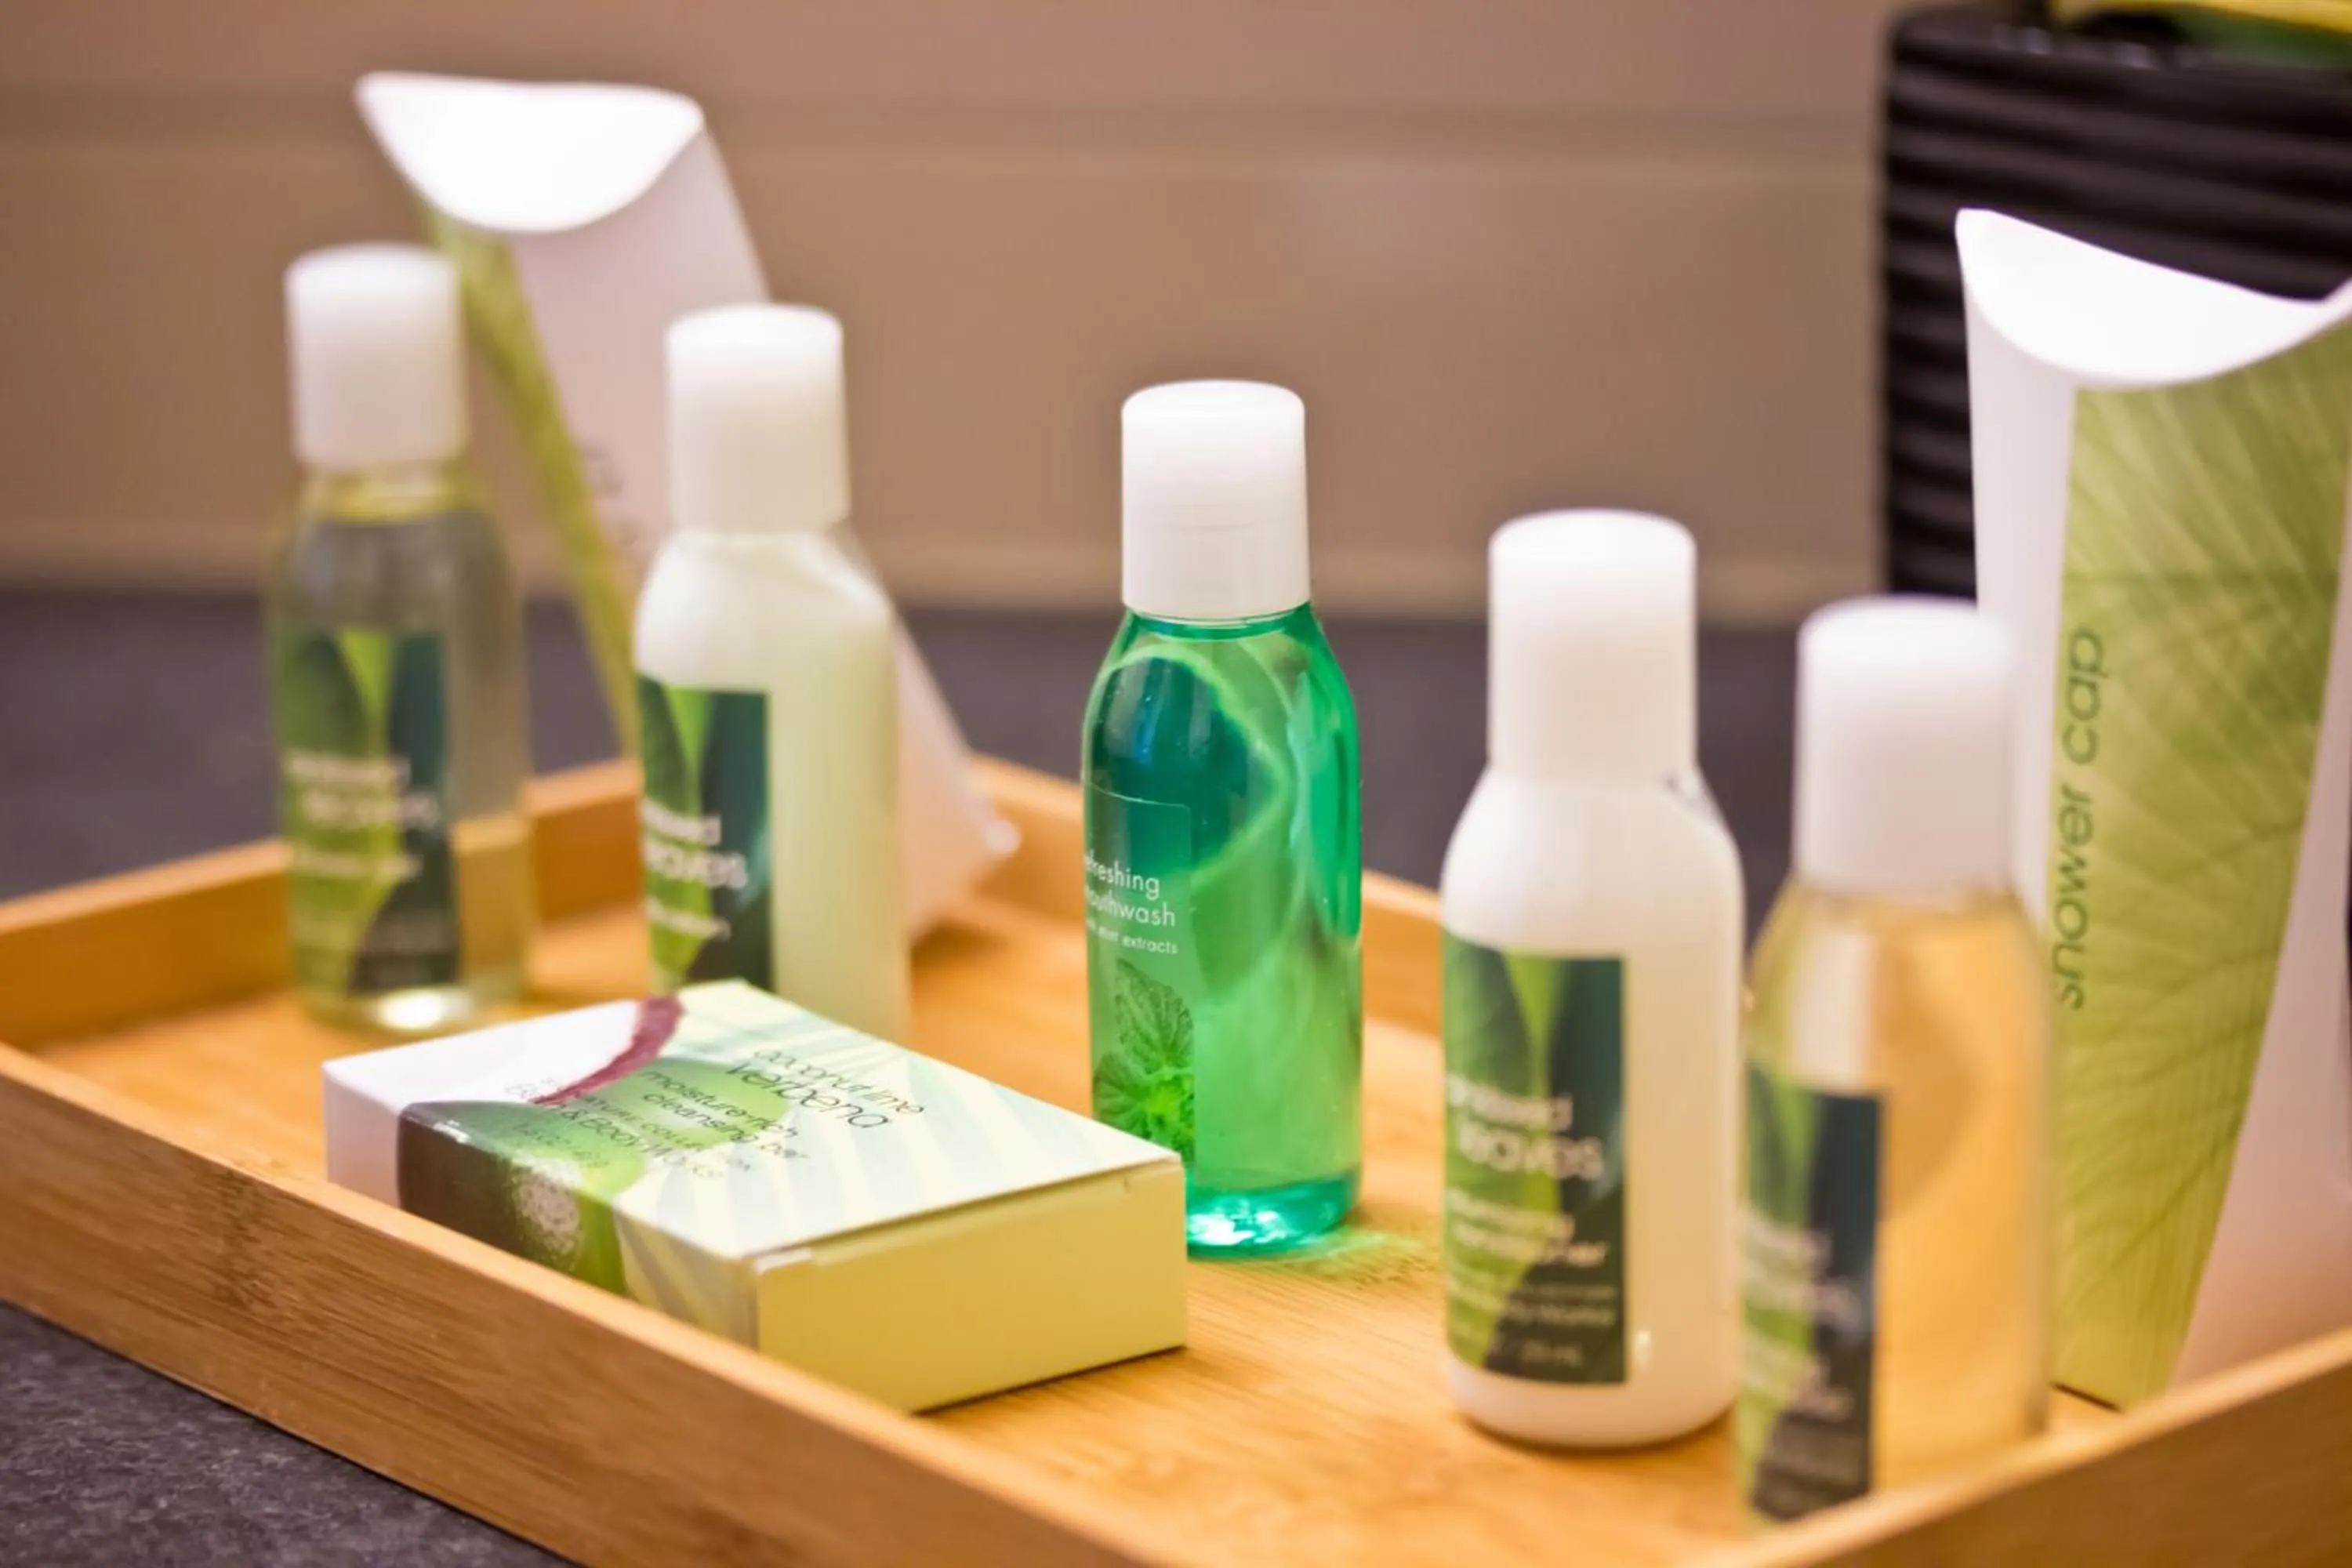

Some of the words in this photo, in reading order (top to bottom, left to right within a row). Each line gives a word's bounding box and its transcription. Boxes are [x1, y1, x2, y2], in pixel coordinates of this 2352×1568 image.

[2061, 626, 2109, 765] cap
[1085, 885, 1175, 927] outhwash
[1122, 935, 1178, 954] extracts
[726, 1062, 892, 1128] verbena
